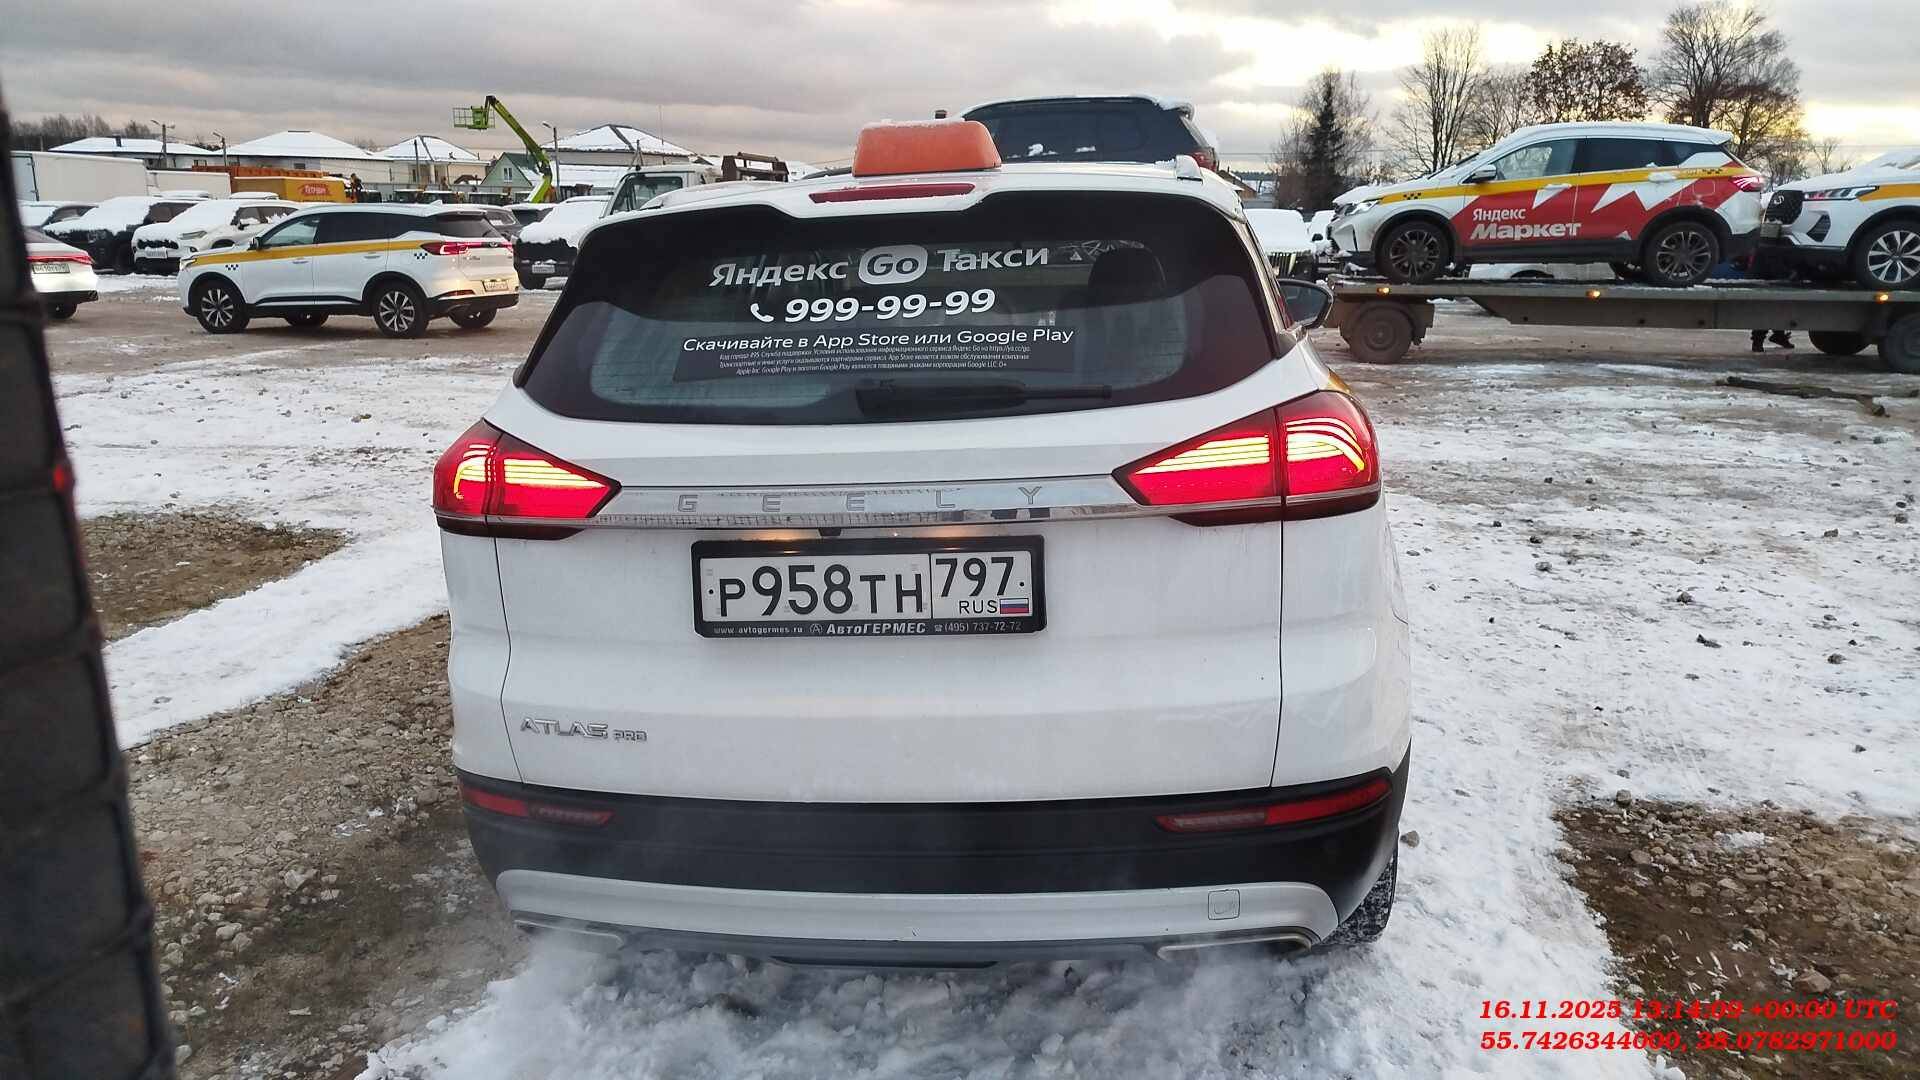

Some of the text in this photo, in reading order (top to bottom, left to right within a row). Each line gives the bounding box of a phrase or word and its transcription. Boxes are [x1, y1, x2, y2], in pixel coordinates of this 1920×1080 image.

[1473, 208, 1526, 222] Яндекс
[1470, 222, 1582, 240] Маркет
[708, 247, 1049, 287] Яндекс Go Такси
[784, 288, 996, 323] 999-99-99
[683, 328, 1074, 351] Скачивайте в App Store или Google Play
[677, 485, 1043, 513] GEELY
[719, 556, 1015, 617] Р958ТН 797
[958, 600, 998, 615] RUS
[944, 621, 969, 633] (495)
[973, 620, 1022, 632] 737-72-72
[520, 717, 648, 742] ATLAS PRO
